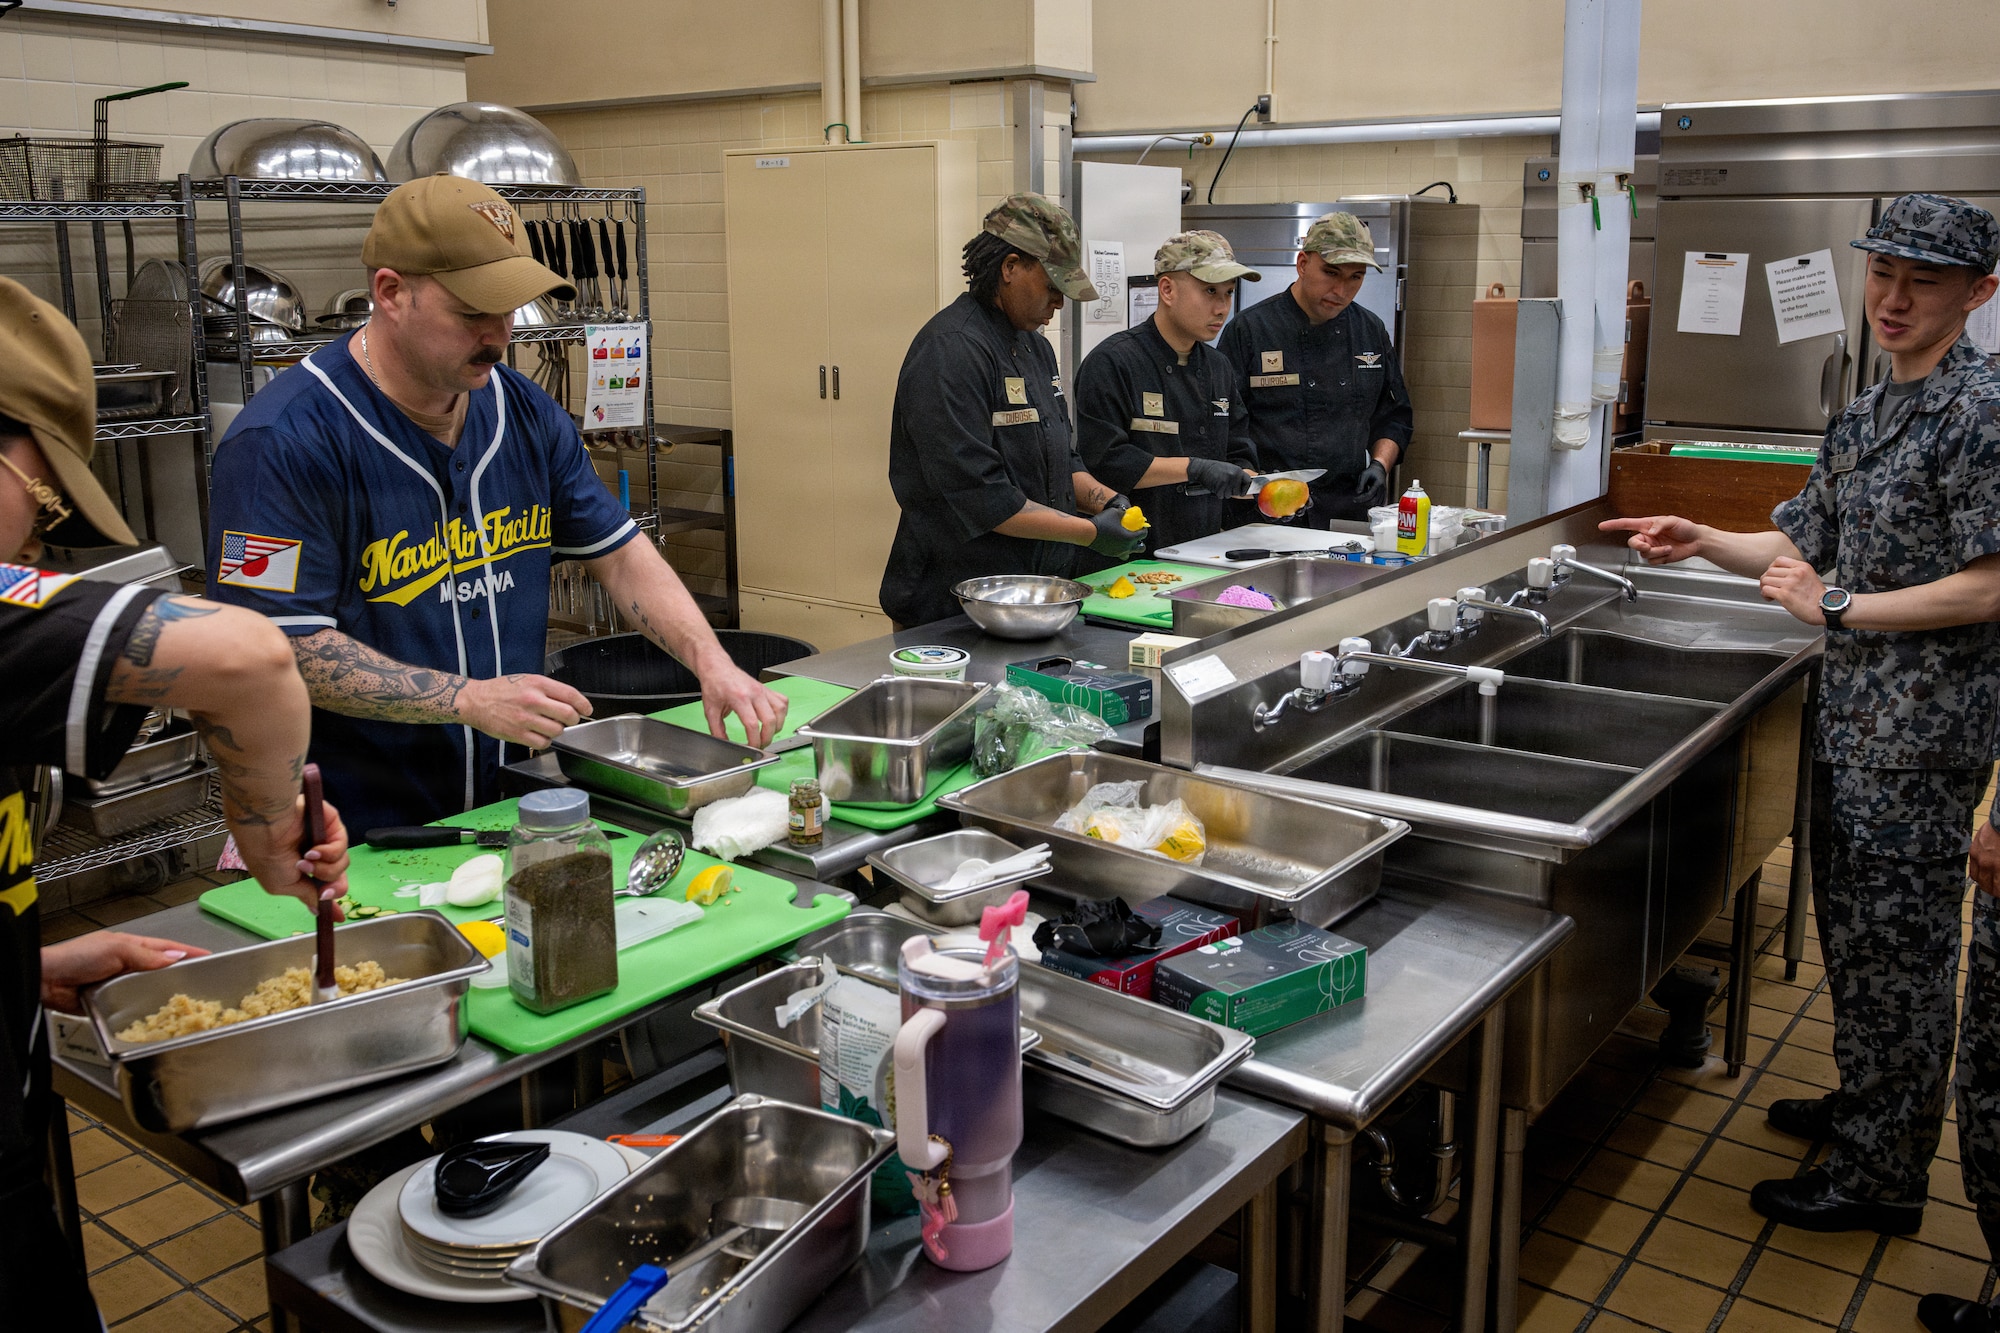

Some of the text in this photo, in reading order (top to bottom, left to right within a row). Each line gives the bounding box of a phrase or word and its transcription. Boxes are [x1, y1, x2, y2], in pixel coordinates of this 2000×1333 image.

[1778, 287, 1795, 295] newest
[1805, 290, 1820, 298] oldest
[1804, 311, 1819, 319] oldest
[1260, 376, 1288, 387] QUIROGA
[1006, 410, 1033, 424] DUBOSE
[1153, 421, 1161, 431] VU
[359, 504, 551, 593] Naval Air Facilit
[440, 570, 515, 604] MSAWA
[842, 1019, 866, 1031] Bolivian
[860, 1017, 877, 1028] Royal
